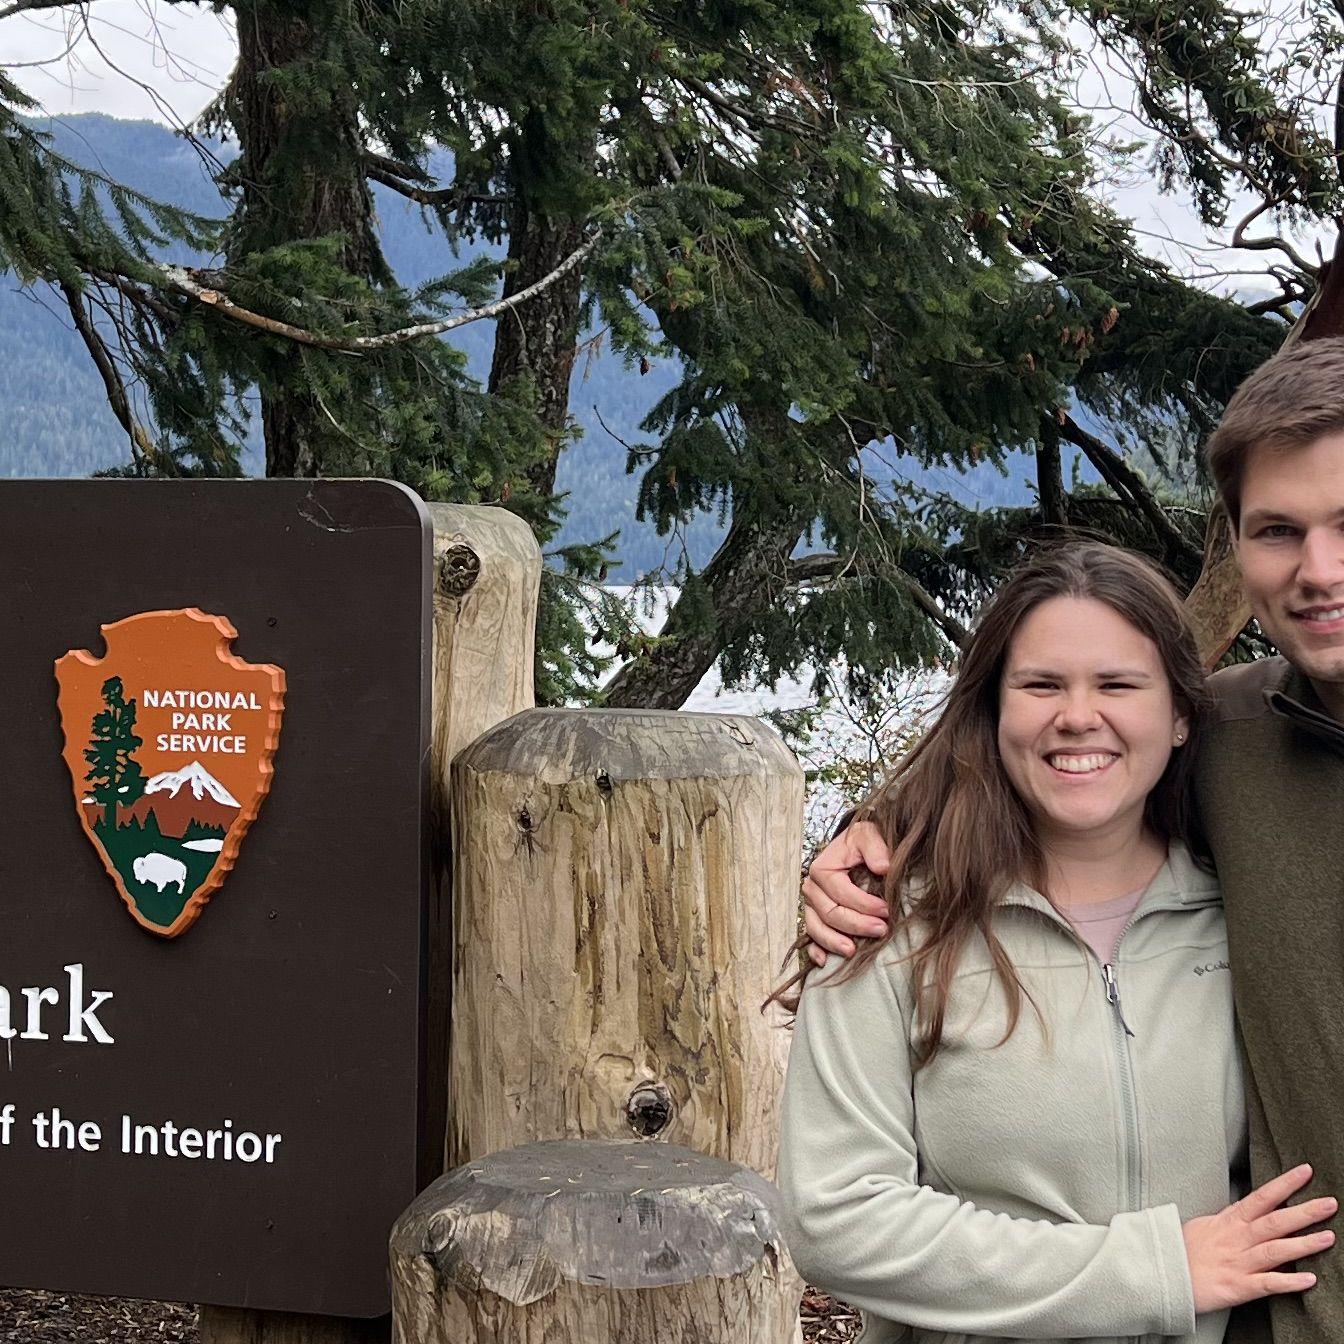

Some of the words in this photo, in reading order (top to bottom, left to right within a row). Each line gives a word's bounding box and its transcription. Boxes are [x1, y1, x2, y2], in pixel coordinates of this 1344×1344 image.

[143, 689, 262, 710] NATIONAL
[172, 712, 232, 731] PARK
[156, 733, 246, 754] SERVICE
[31, 1107, 102, 1152] the
[121, 1115, 282, 1164] Interior
